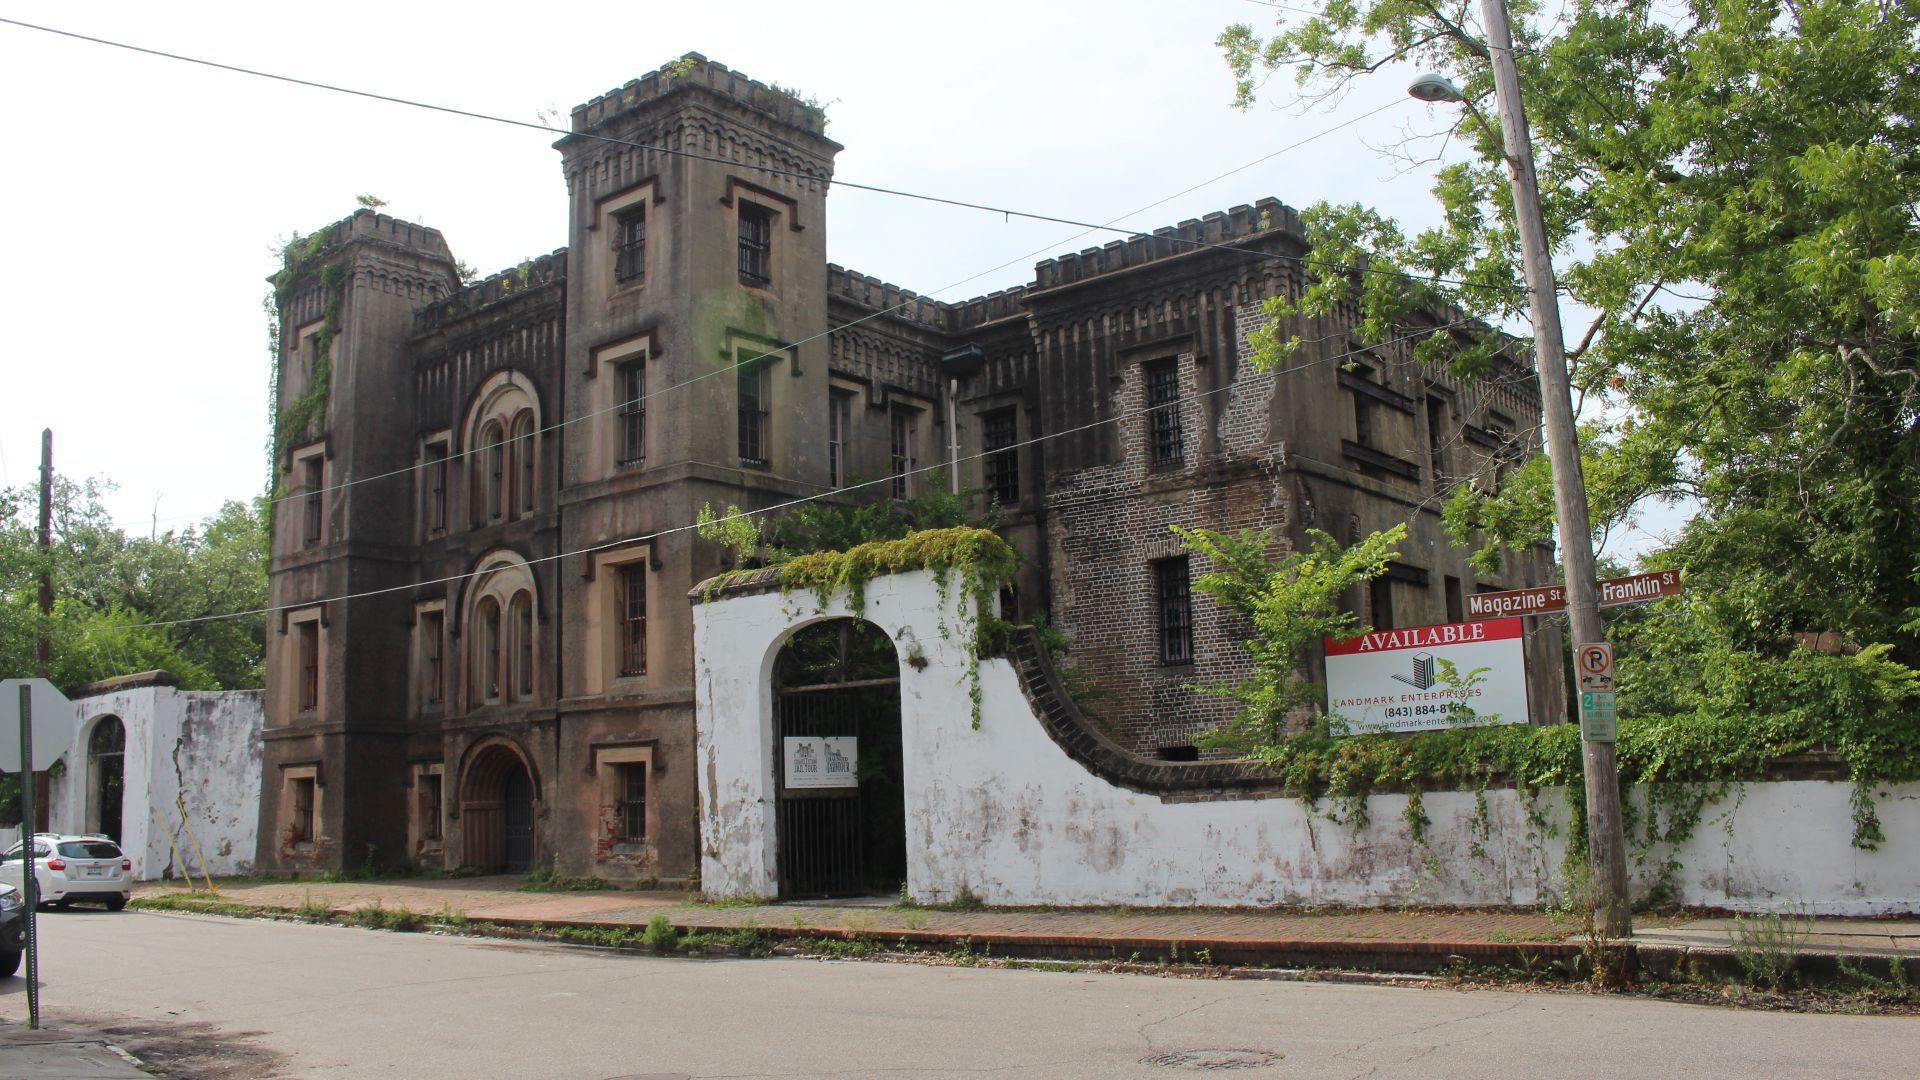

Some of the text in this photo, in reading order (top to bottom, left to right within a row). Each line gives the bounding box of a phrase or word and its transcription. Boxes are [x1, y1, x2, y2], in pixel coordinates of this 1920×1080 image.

[1602, 573, 1674, 601] Franklin St
[1470, 589, 1561, 616] Magazine St
[1358, 623, 1486, 651] AVAILABLE
[1333, 688, 1482, 708] LANDMARK ENTERPRISES
[1384, 707, 1412, 719] (843)
